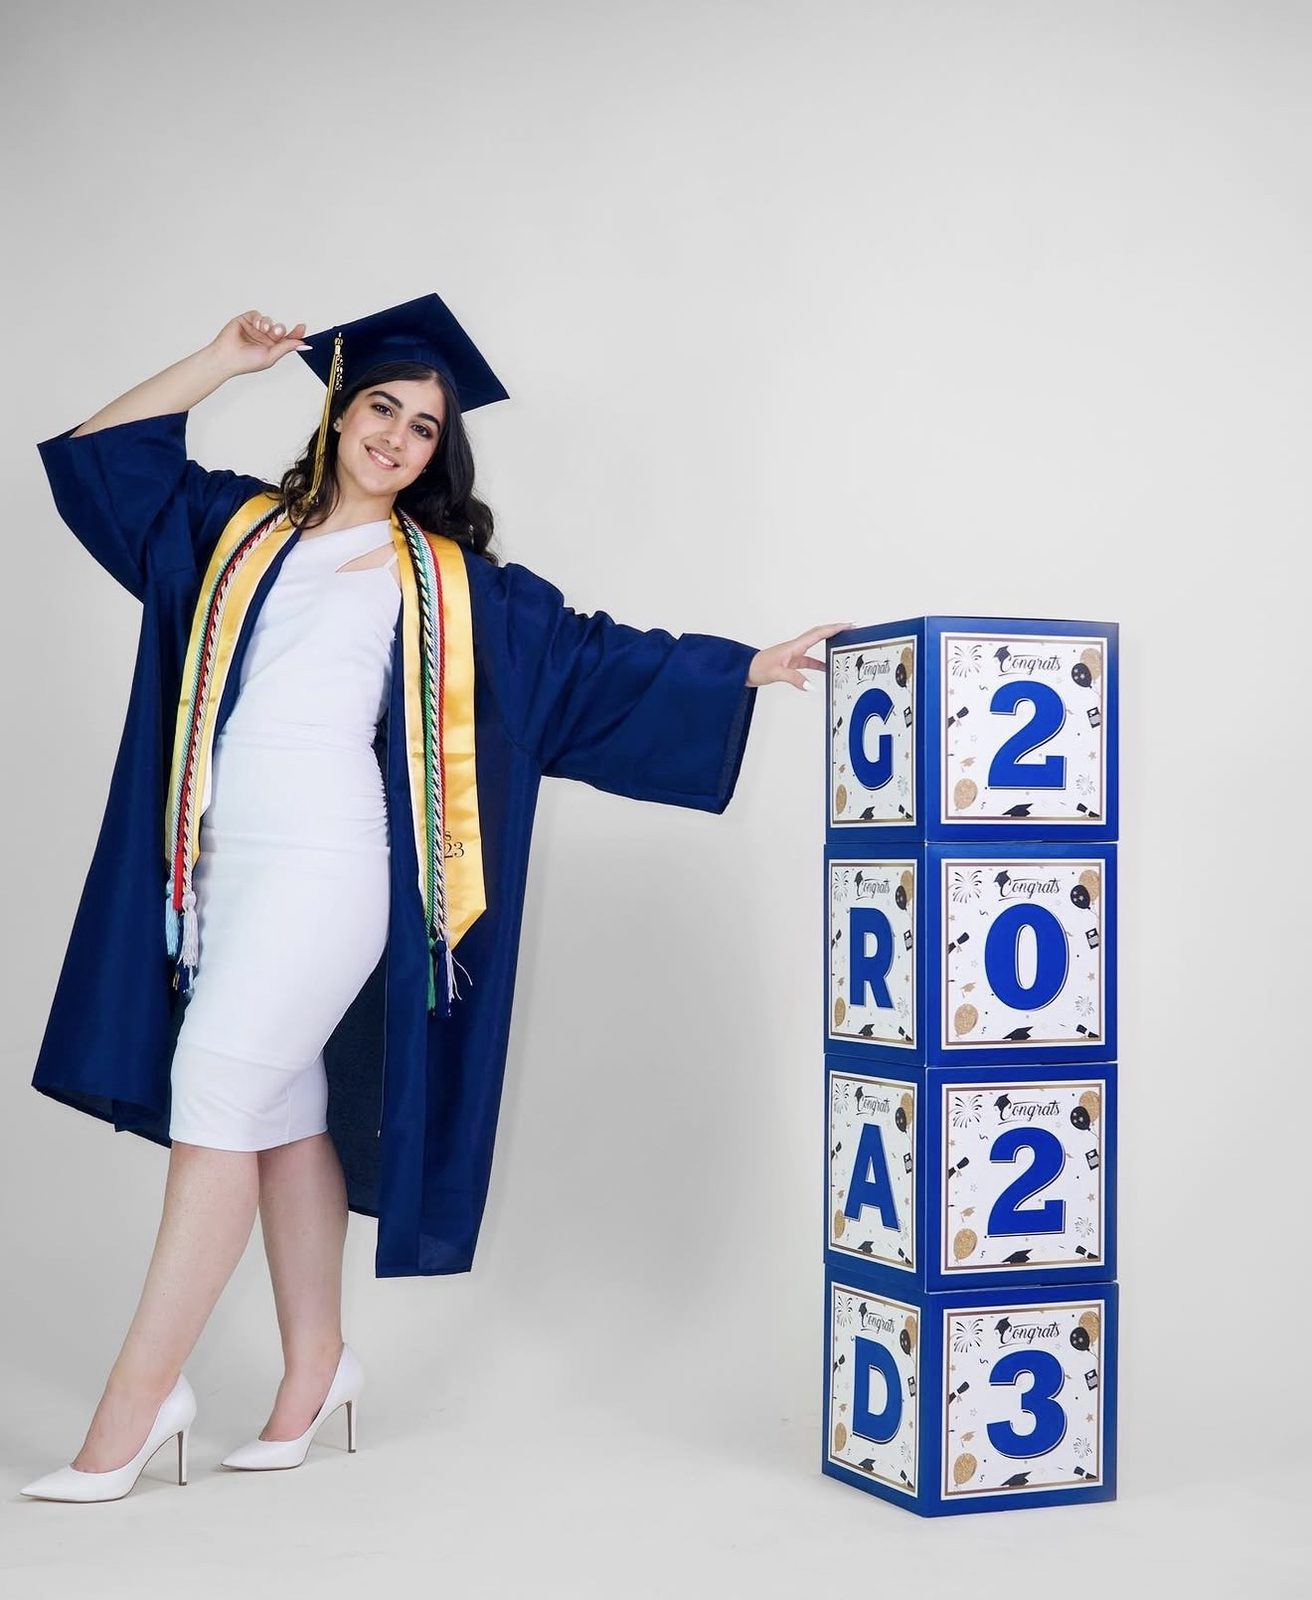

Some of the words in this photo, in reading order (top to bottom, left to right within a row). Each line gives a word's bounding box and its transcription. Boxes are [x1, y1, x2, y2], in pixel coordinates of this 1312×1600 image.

[856, 657, 891, 684] Congrats
[998, 653, 1062, 676] Congrats
[849, 687, 895, 791] G
[988, 680, 1067, 790] 2
[856, 876, 891, 901] Congrats
[998, 877, 1061, 902] Congrats
[848, 906, 895, 1011] R
[856, 1094, 891, 1117] Congrats
[998, 1099, 1061, 1125] Congrats
[844, 1122, 901, 1233] A
[988, 1126, 1067, 1238] 2
[860, 1309, 896, 1334] Congrats
[998, 1321, 1061, 1349] Congrats
[851, 1335, 903, 1445] D
[986, 1349, 1068, 1460] 3
